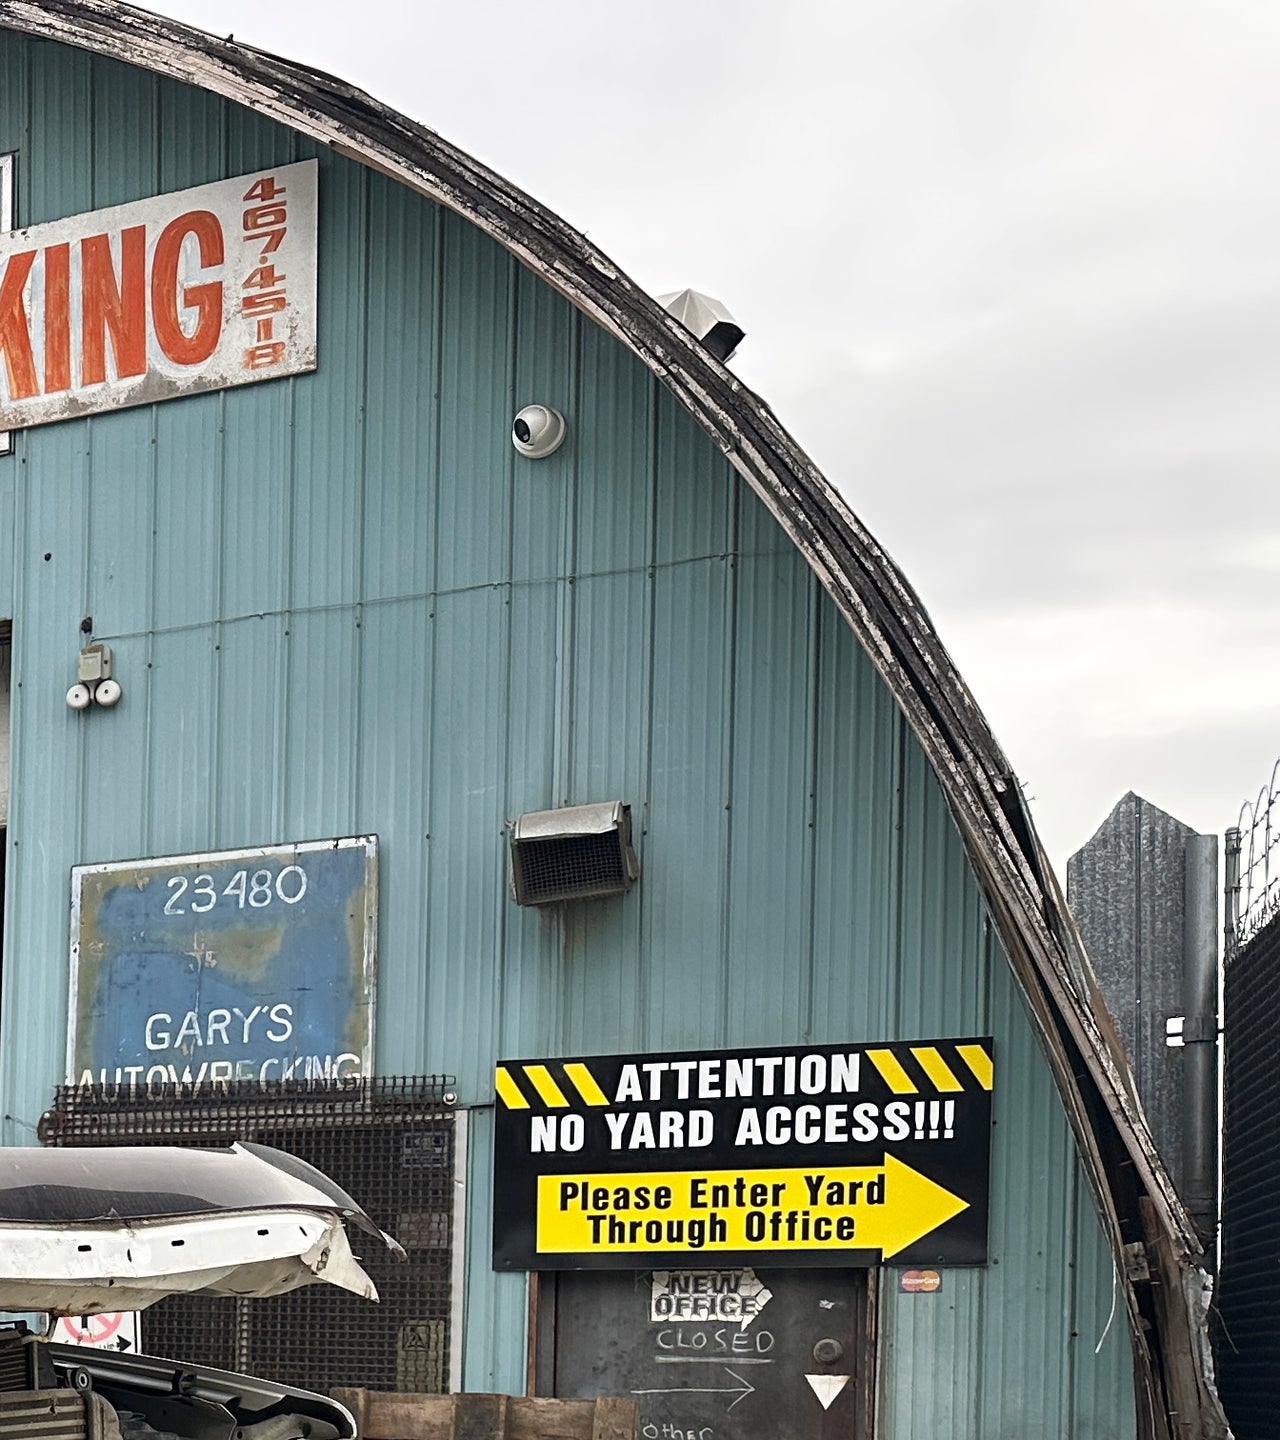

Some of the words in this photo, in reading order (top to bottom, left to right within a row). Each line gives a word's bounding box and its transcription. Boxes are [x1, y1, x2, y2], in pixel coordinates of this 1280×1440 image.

[163, 865, 308, 916] 23480
[144, 1003, 294, 1051] GARY'S
[615, 1053, 861, 1102] ATTENTION
[530, 1113, 585, 1153] NO
[604, 1108, 715, 1150] YARD
[735, 1099, 956, 1147] ACCESS!!!
[559, 1180, 672, 1212] Please
[690, 1178, 786, 1210] Enter
[803, 1173, 887, 1206] Yard
[587, 1212, 727, 1248] Through
[744, 1210, 856, 1244] Office
[654, 1293, 756, 1316] OFFICE
[670, 1273, 740, 1294] NEW
